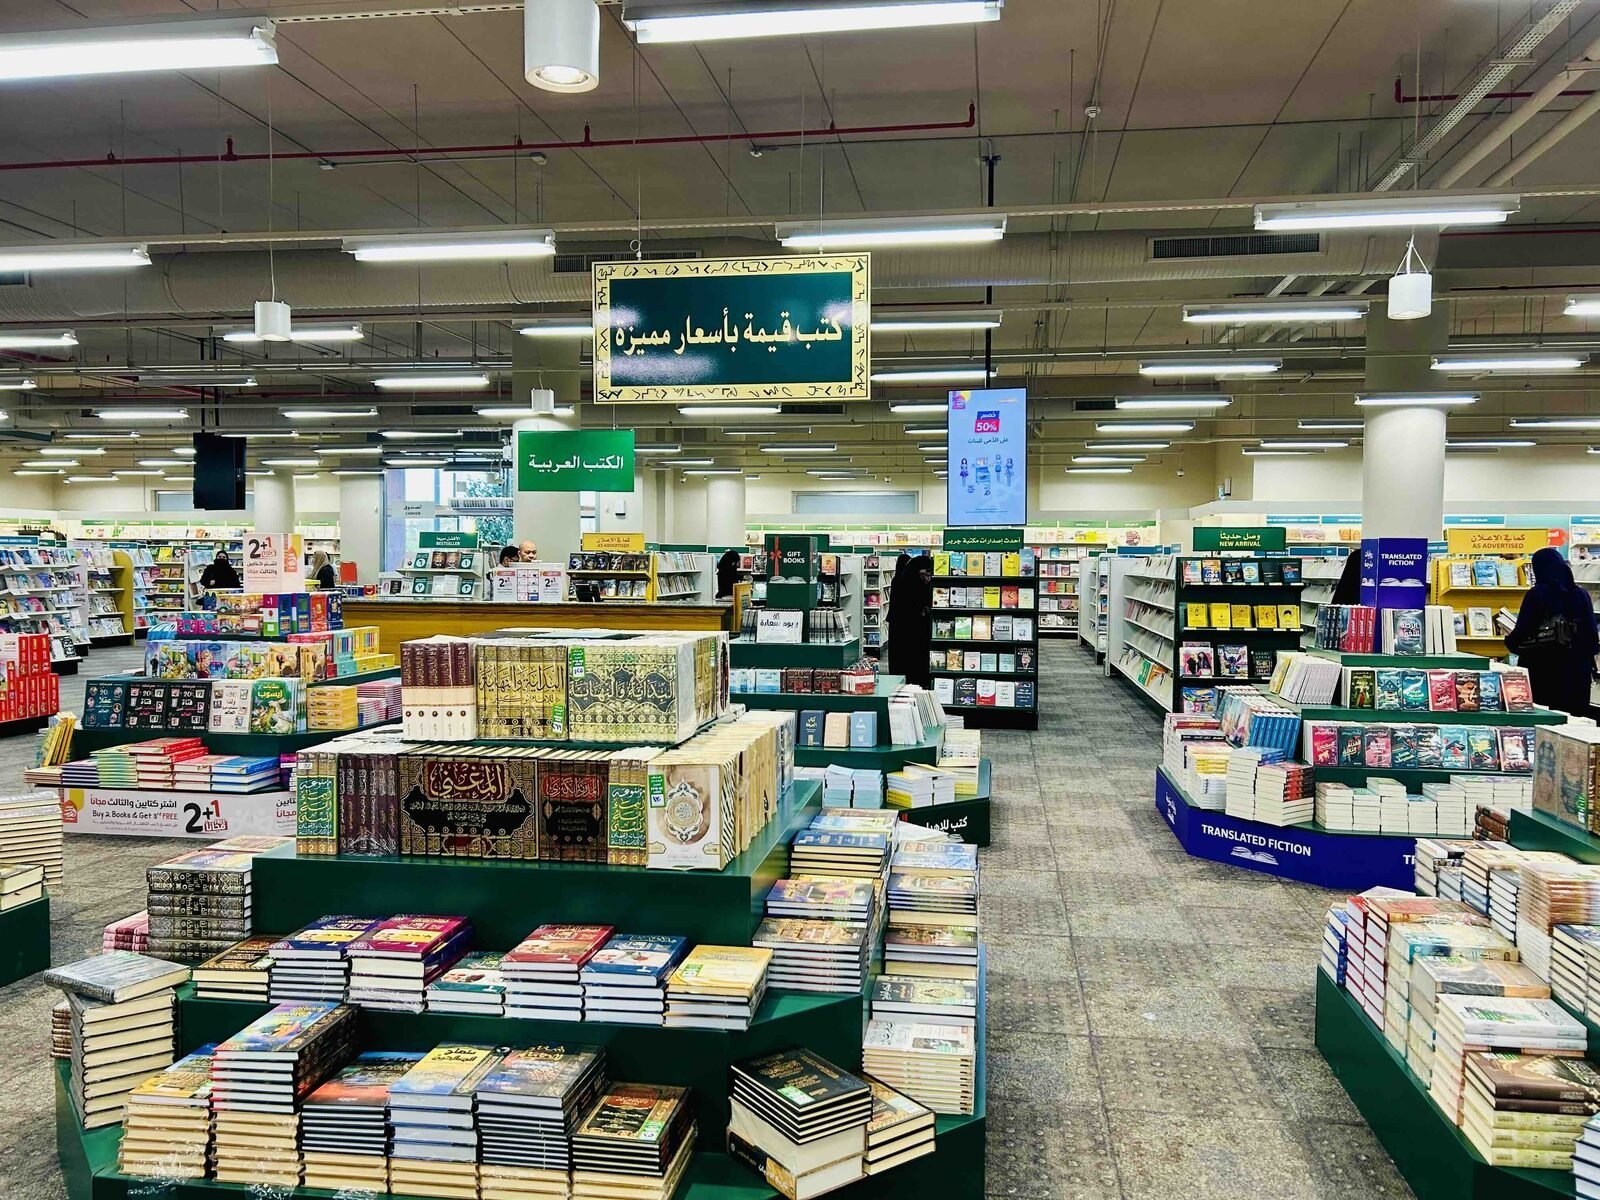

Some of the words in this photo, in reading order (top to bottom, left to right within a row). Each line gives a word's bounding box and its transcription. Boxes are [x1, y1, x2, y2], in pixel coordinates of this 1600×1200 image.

[615, 320, 671, 355] مميزة
[674, 307, 739, 355] بأسعار
[743, 310, 792, 353] قيمة
[796, 310, 846, 350] كتب
[976, 422, 997, 432] 50%
[528, 454, 580, 473] العربية
[582, 455, 624, 472] الكتب
[249, 536, 272, 559] 2+1
[522, 665, 564, 692] البداية
[107, 799, 134, 808] والثالث
[135, 800, 158, 809] كتابين
[160, 801, 177, 809] اشتر
[276, 797, 297, 807] تابين
[92, 810, 104, 819] Buy
[183, 800, 220, 833] 2+1
[950, 816, 968, 832] كتب
[1201, 824, 1266, 847] TRANSLATED
[1268, 838, 1311, 856] FICTION
[610, 855, 616, 863] 1
[621, 855, 627, 863] 2
[631, 855, 638, 863] 3
